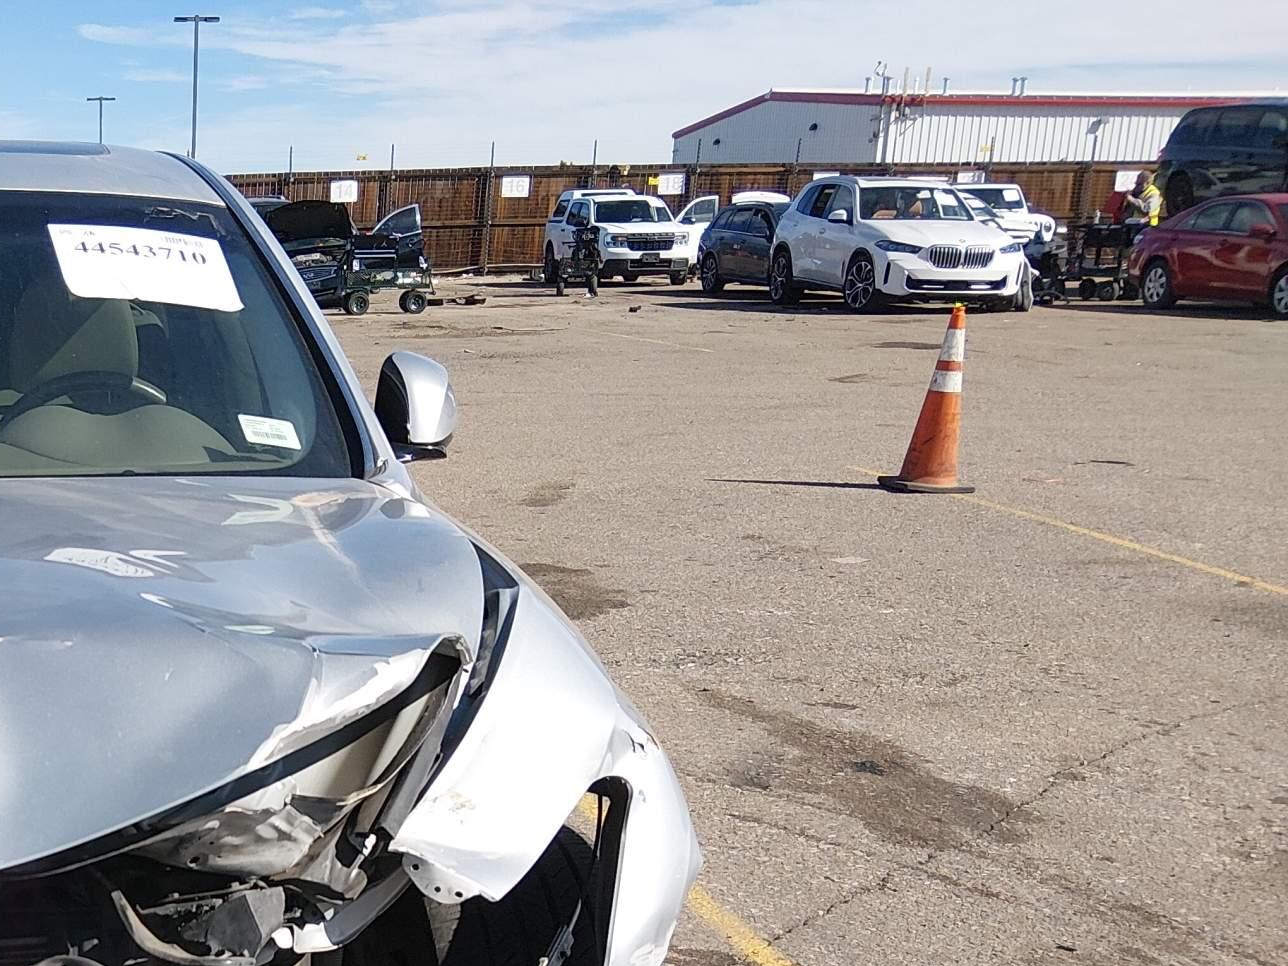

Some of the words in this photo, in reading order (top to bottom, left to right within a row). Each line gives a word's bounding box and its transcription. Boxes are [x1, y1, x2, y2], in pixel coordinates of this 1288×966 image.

[335, 183, 353, 199] 14
[507, 179, 526, 194] 16
[74, 241, 207, 265] 44543710
